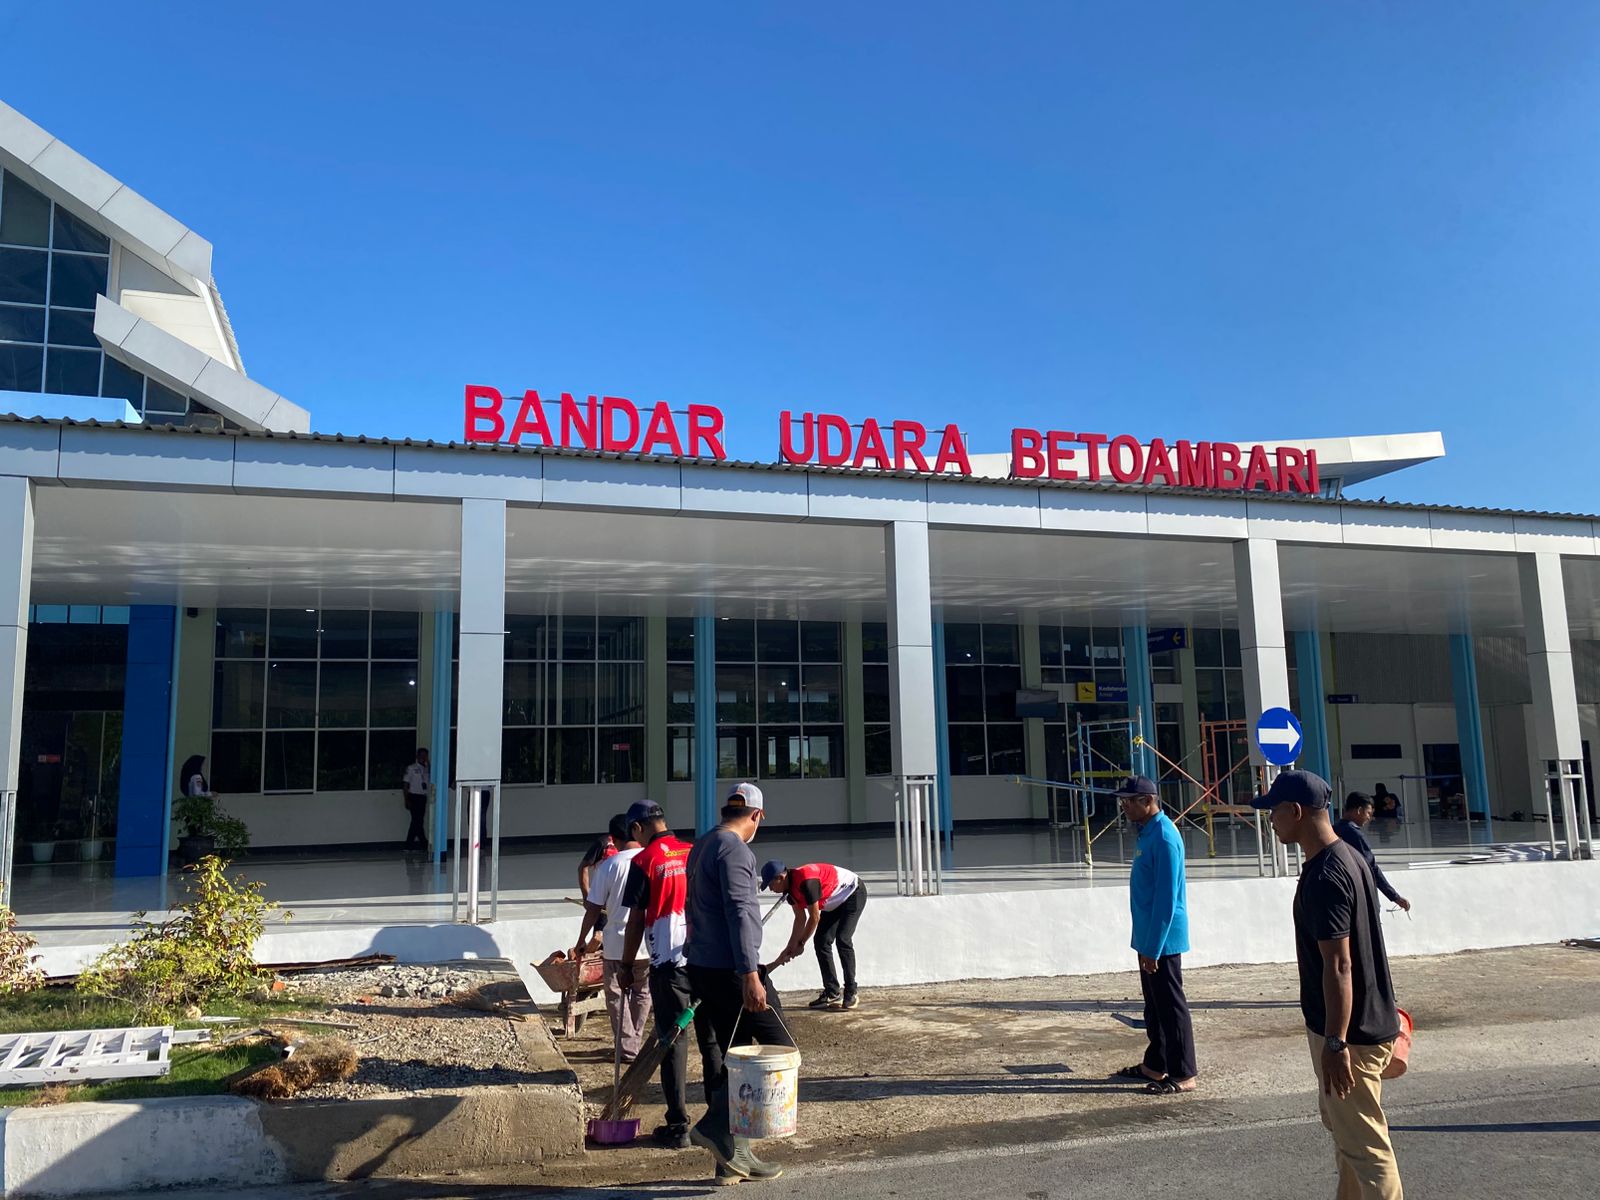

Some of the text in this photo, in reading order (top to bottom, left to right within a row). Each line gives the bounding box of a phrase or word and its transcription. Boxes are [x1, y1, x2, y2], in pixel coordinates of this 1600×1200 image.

[465, 385, 1320, 494] BANDAR UDARA BETOAMBARI
